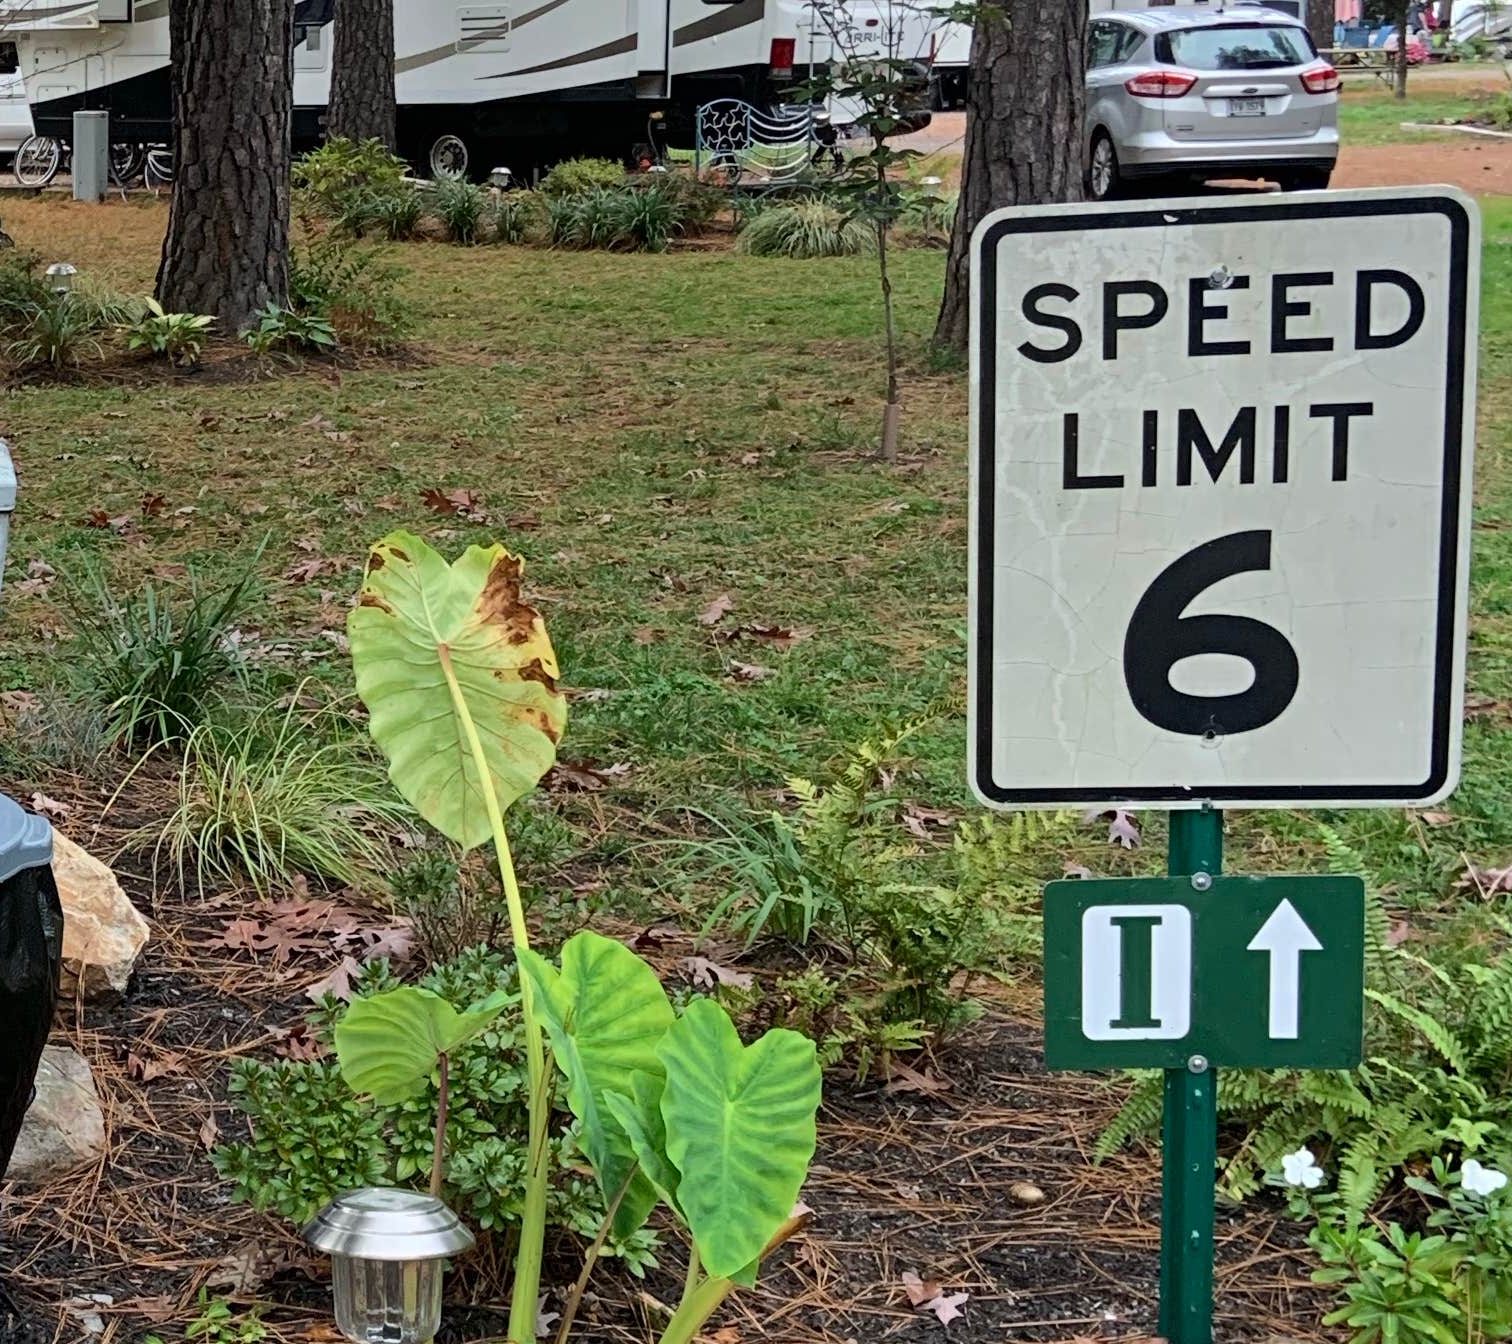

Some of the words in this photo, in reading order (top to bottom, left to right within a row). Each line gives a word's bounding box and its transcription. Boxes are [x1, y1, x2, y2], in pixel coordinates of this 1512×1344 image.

[1016, 268, 1426, 364] SPEED
[1062, 401, 1374, 490] LIMIT
[1123, 529, 1300, 736] 6
[1109, 915, 1163, 1029] I
